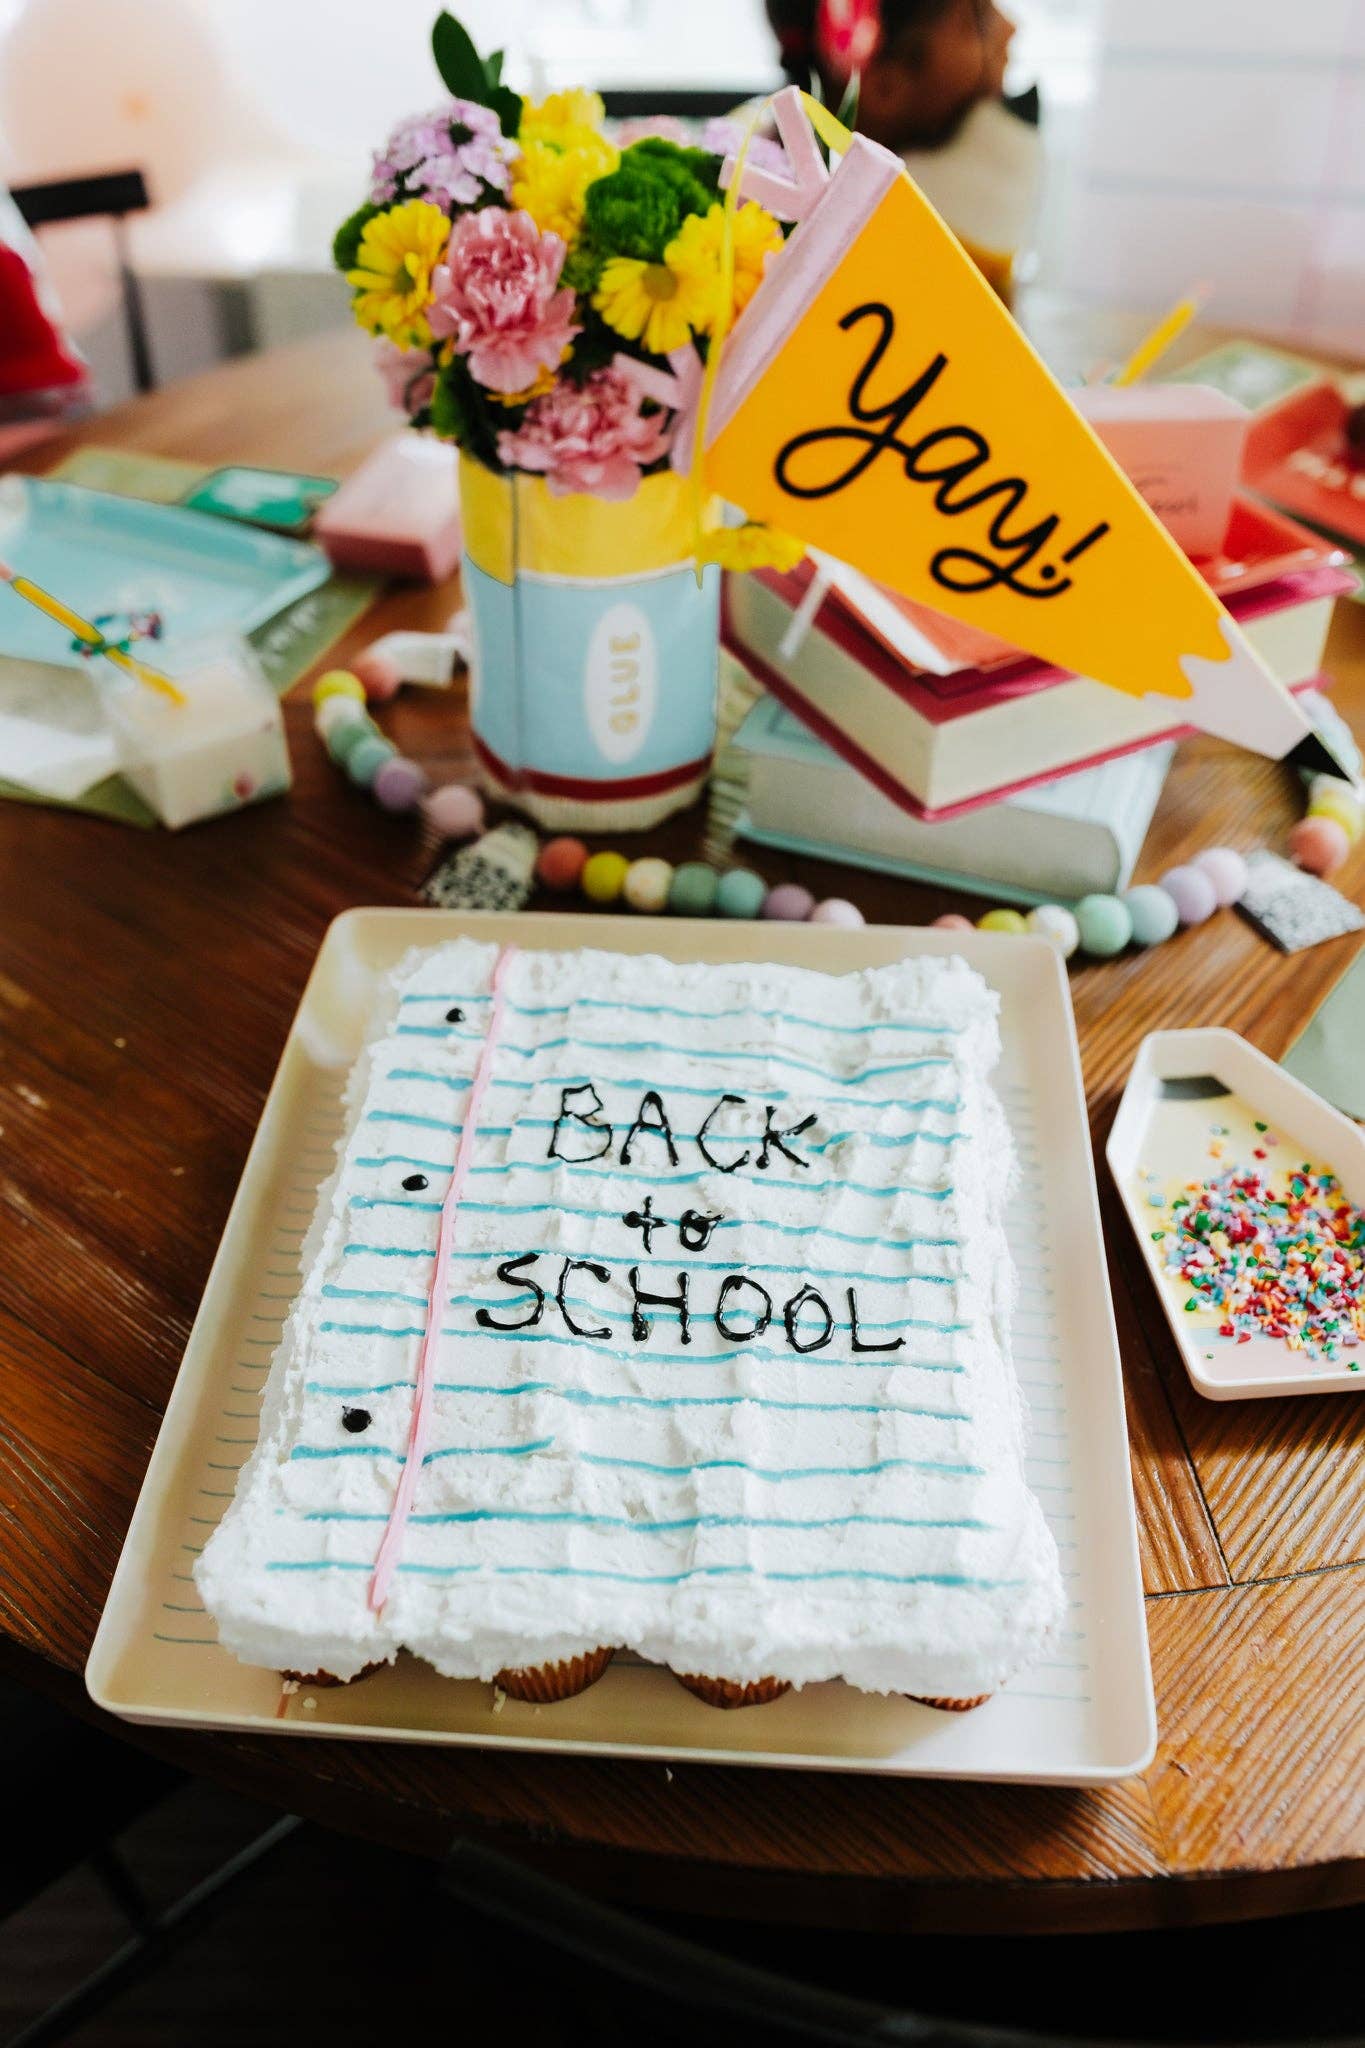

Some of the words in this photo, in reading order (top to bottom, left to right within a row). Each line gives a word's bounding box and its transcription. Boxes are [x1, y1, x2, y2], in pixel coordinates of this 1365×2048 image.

[775, 302, 1110, 598] Yay!
[609, 632, 640, 735] GLUE
[547, 1083, 818, 1174] BACK
[622, 1195, 724, 1254] to
[475, 1252, 907, 1353] SCHOOL
